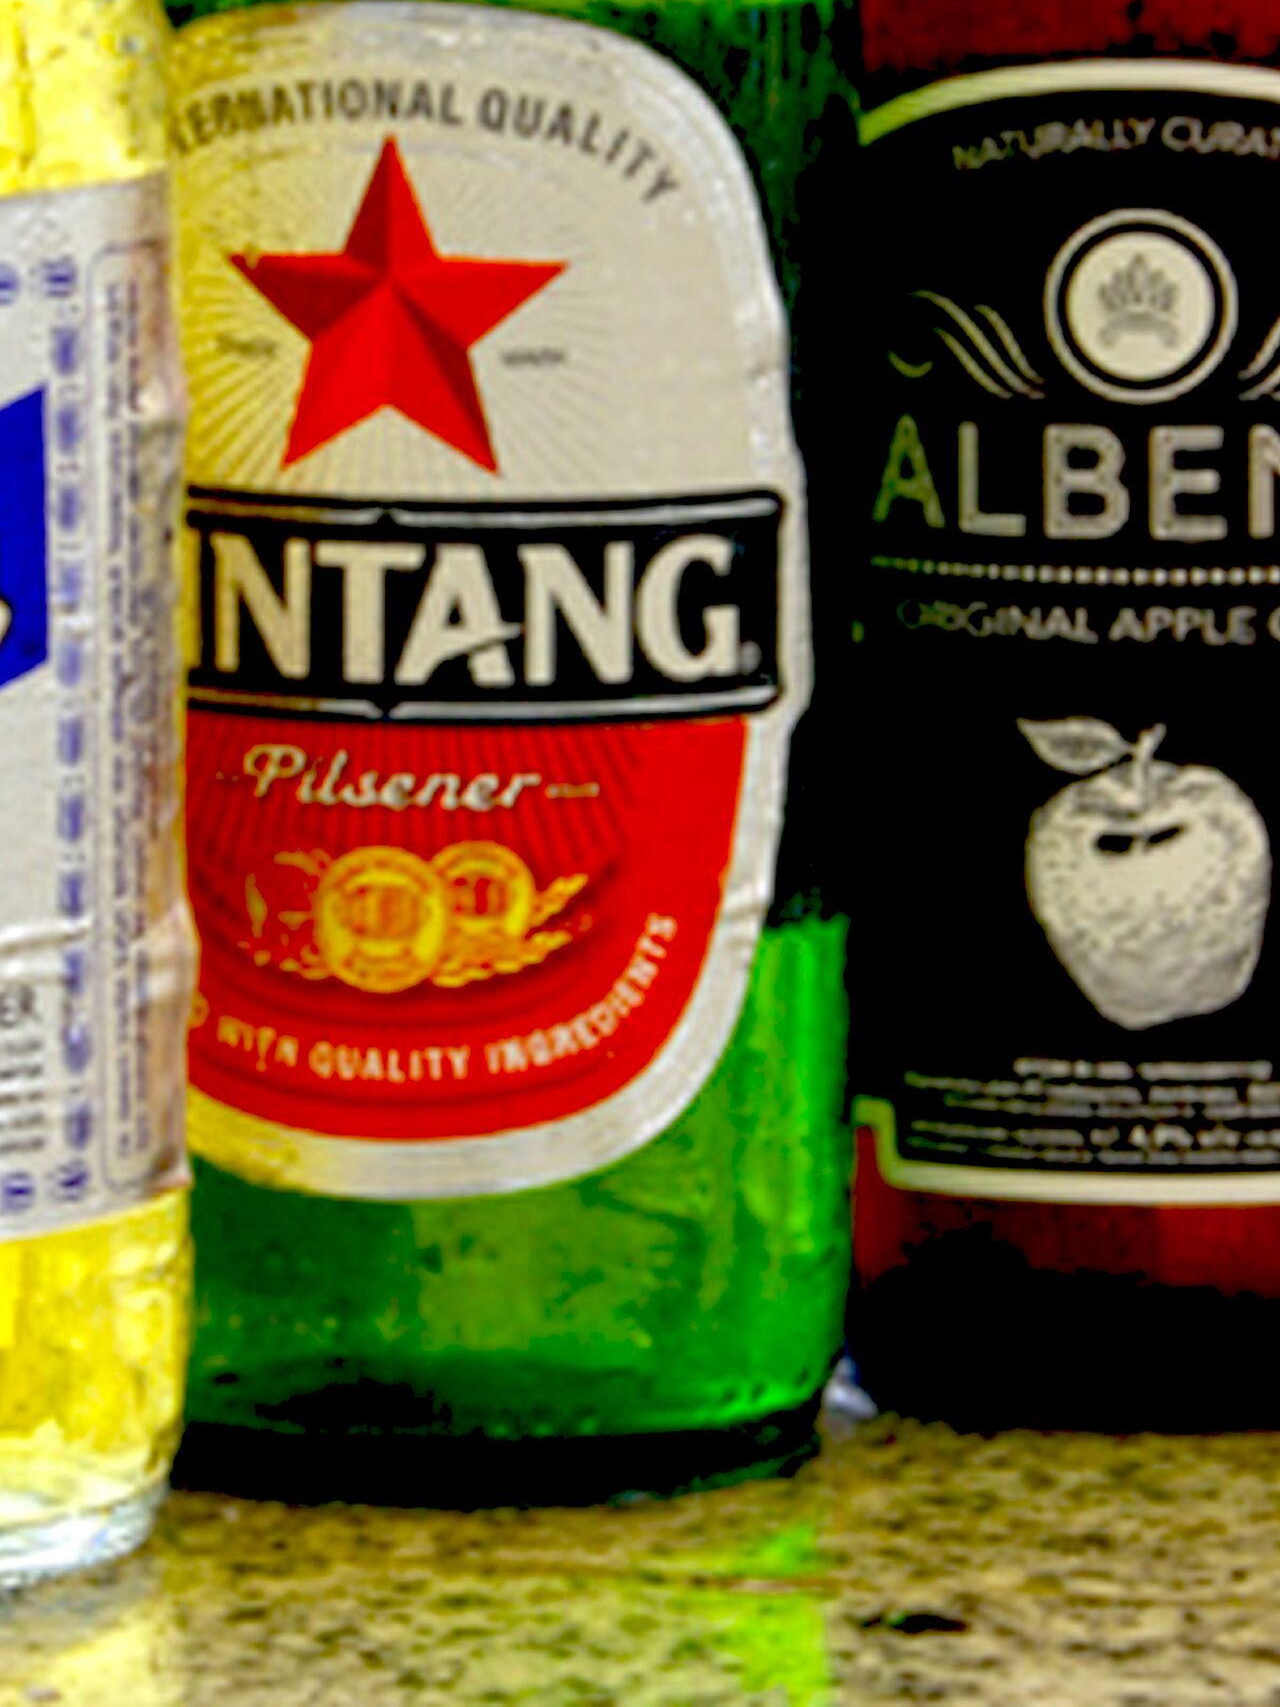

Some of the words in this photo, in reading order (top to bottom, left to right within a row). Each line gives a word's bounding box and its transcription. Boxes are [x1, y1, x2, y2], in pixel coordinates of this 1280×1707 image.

[475, 87, 680, 205] QUALITY
[951, 117, 1156, 170] NATURALLY
[1107, 604, 1258, 646] APPLE
[242, 742, 542, 812] Pilsener
[308, 1039, 471, 1084] QUALITY
